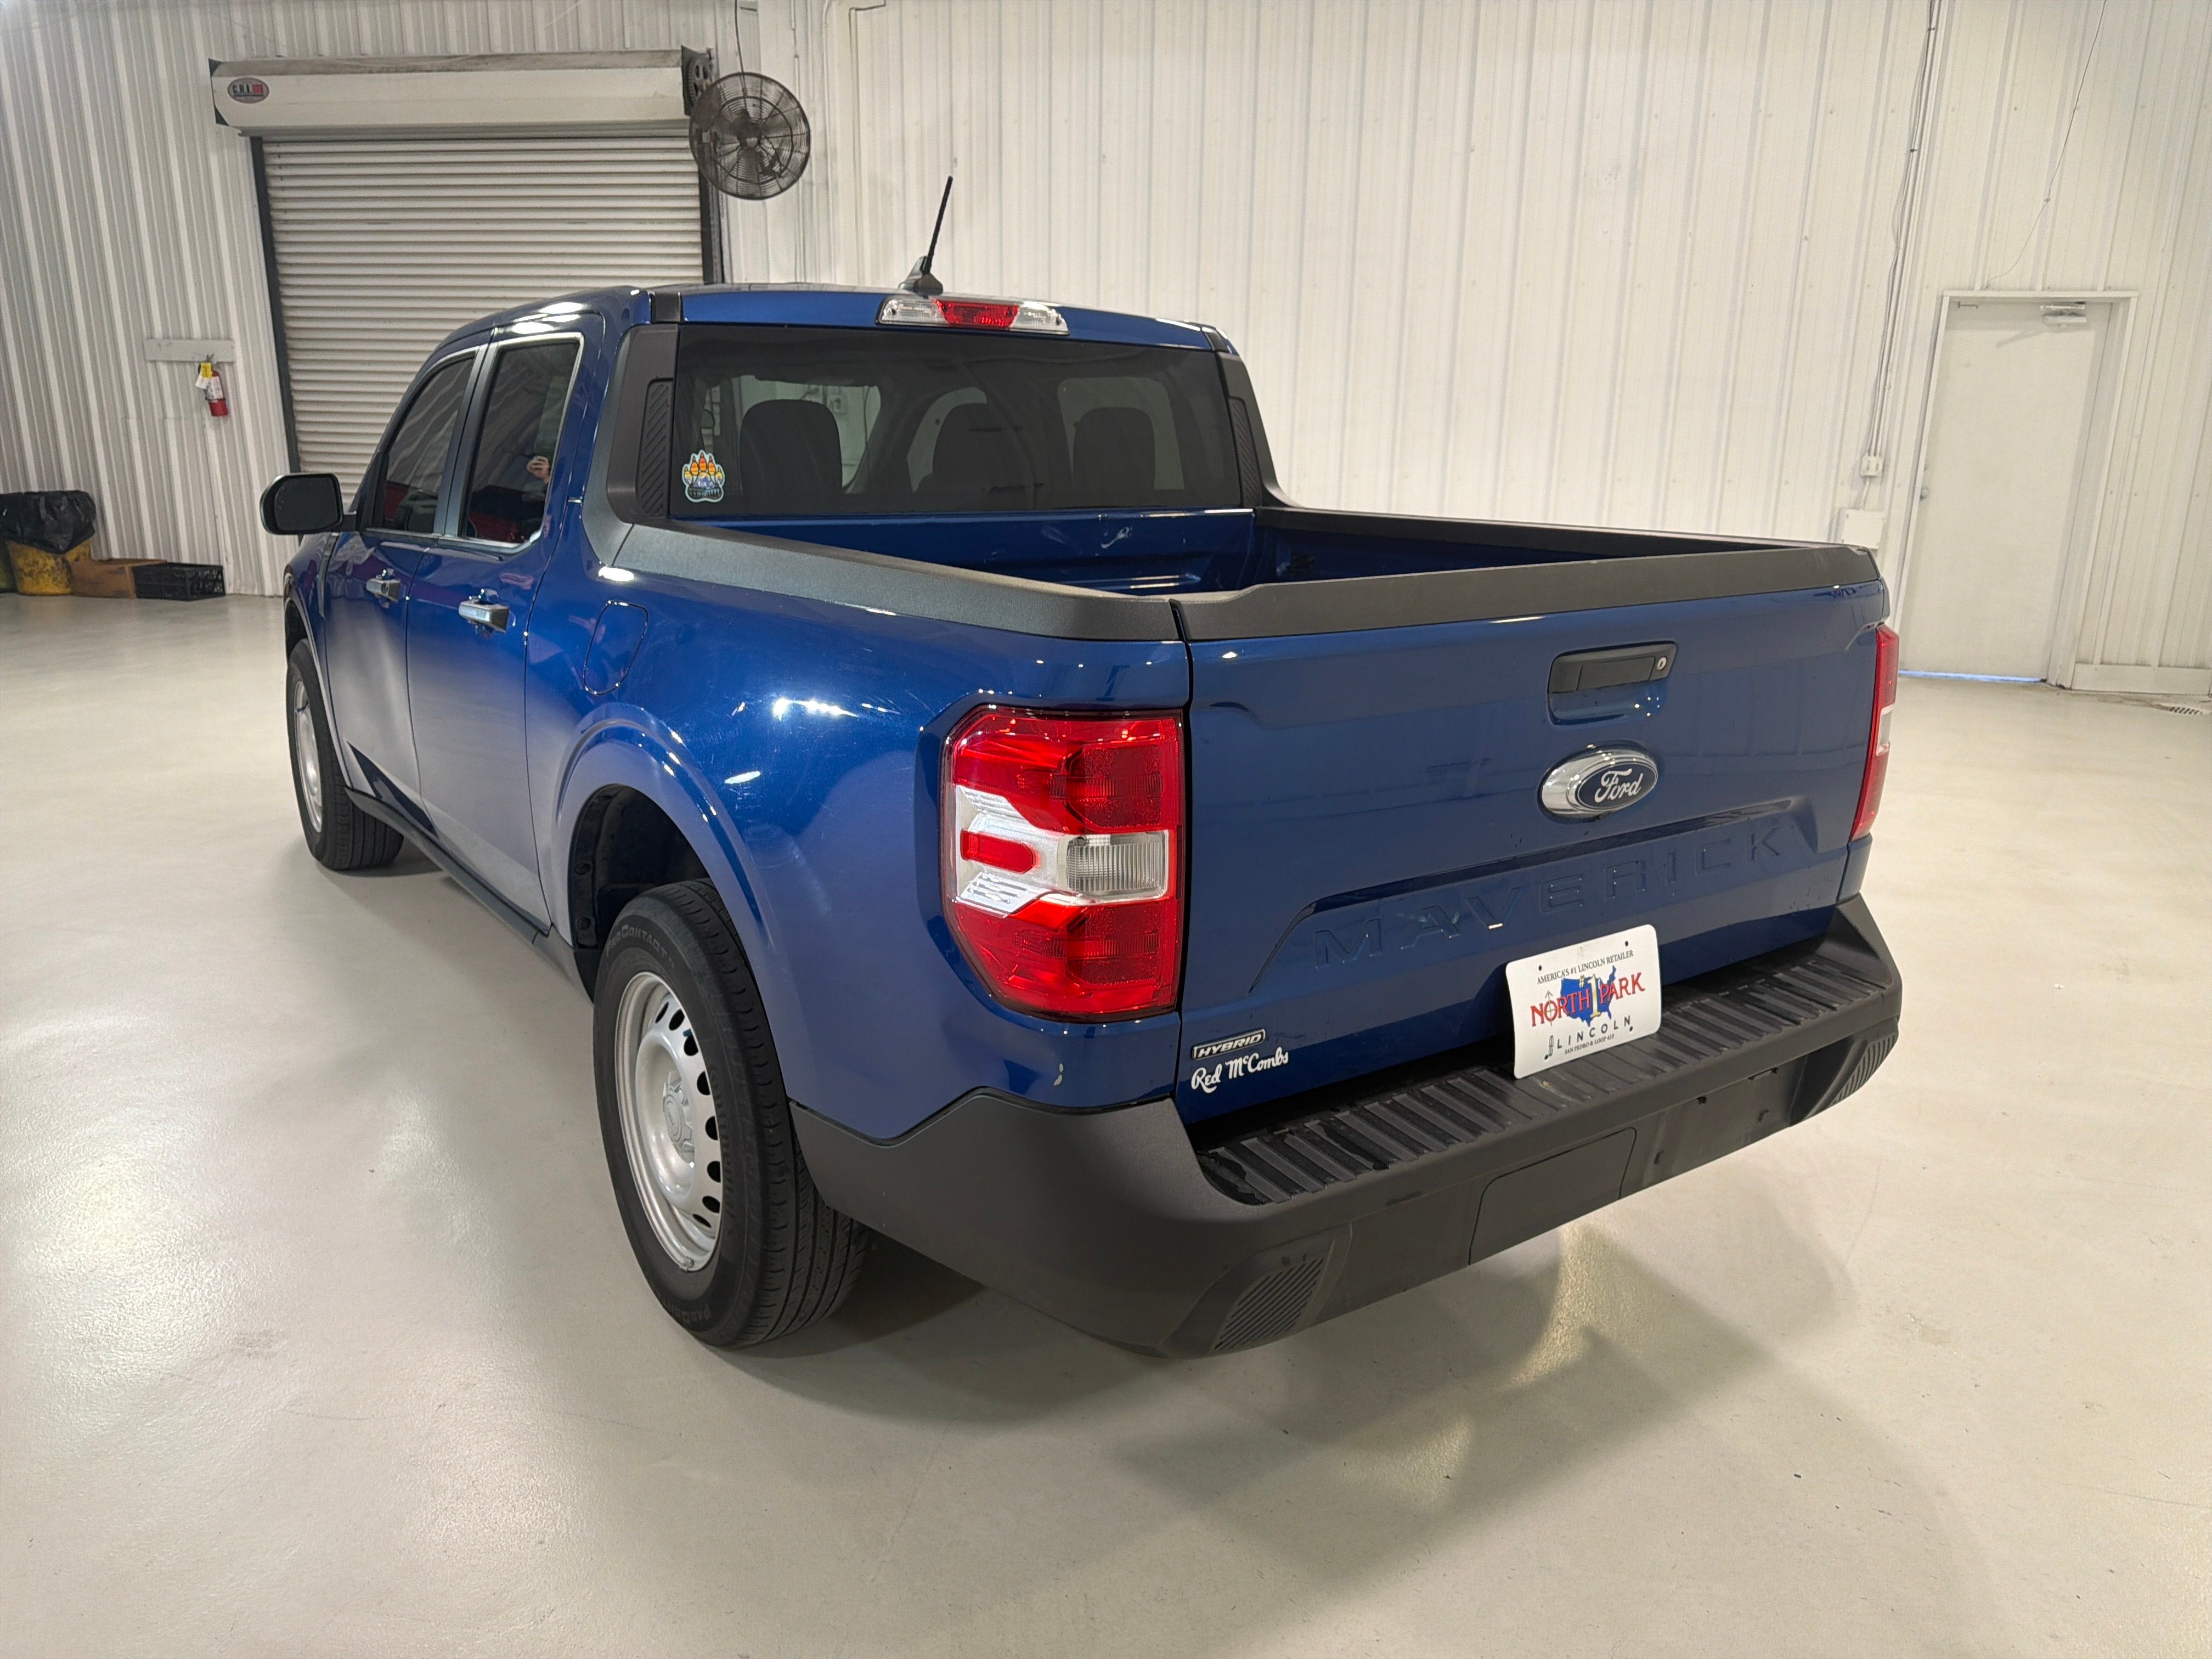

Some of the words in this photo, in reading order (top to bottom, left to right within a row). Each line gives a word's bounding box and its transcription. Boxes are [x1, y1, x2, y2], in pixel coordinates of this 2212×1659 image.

[1594, 768, 1644, 803] Ford
[1313, 825, 1781, 969] MAVERICK
[1537, 969, 1570, 985] AMERICA'S
[1577, 958, 1606, 973] LINCOLN
[1606, 950, 1634, 963] RETAILER
[1530, 988, 1591, 1027] NORTH
[1600, 972, 1645, 1005] PARK
[1198, 1034, 1262, 1057] HYBRID
[1557, 1015, 1630, 1049] LINCOLN
[1574, 1042, 1589, 1052] PEDRO
[1594, 1036, 1607, 1045] LOOP
[1191, 1063, 1222, 1093] Red
[1225, 1047, 1289, 1079] McCombs
